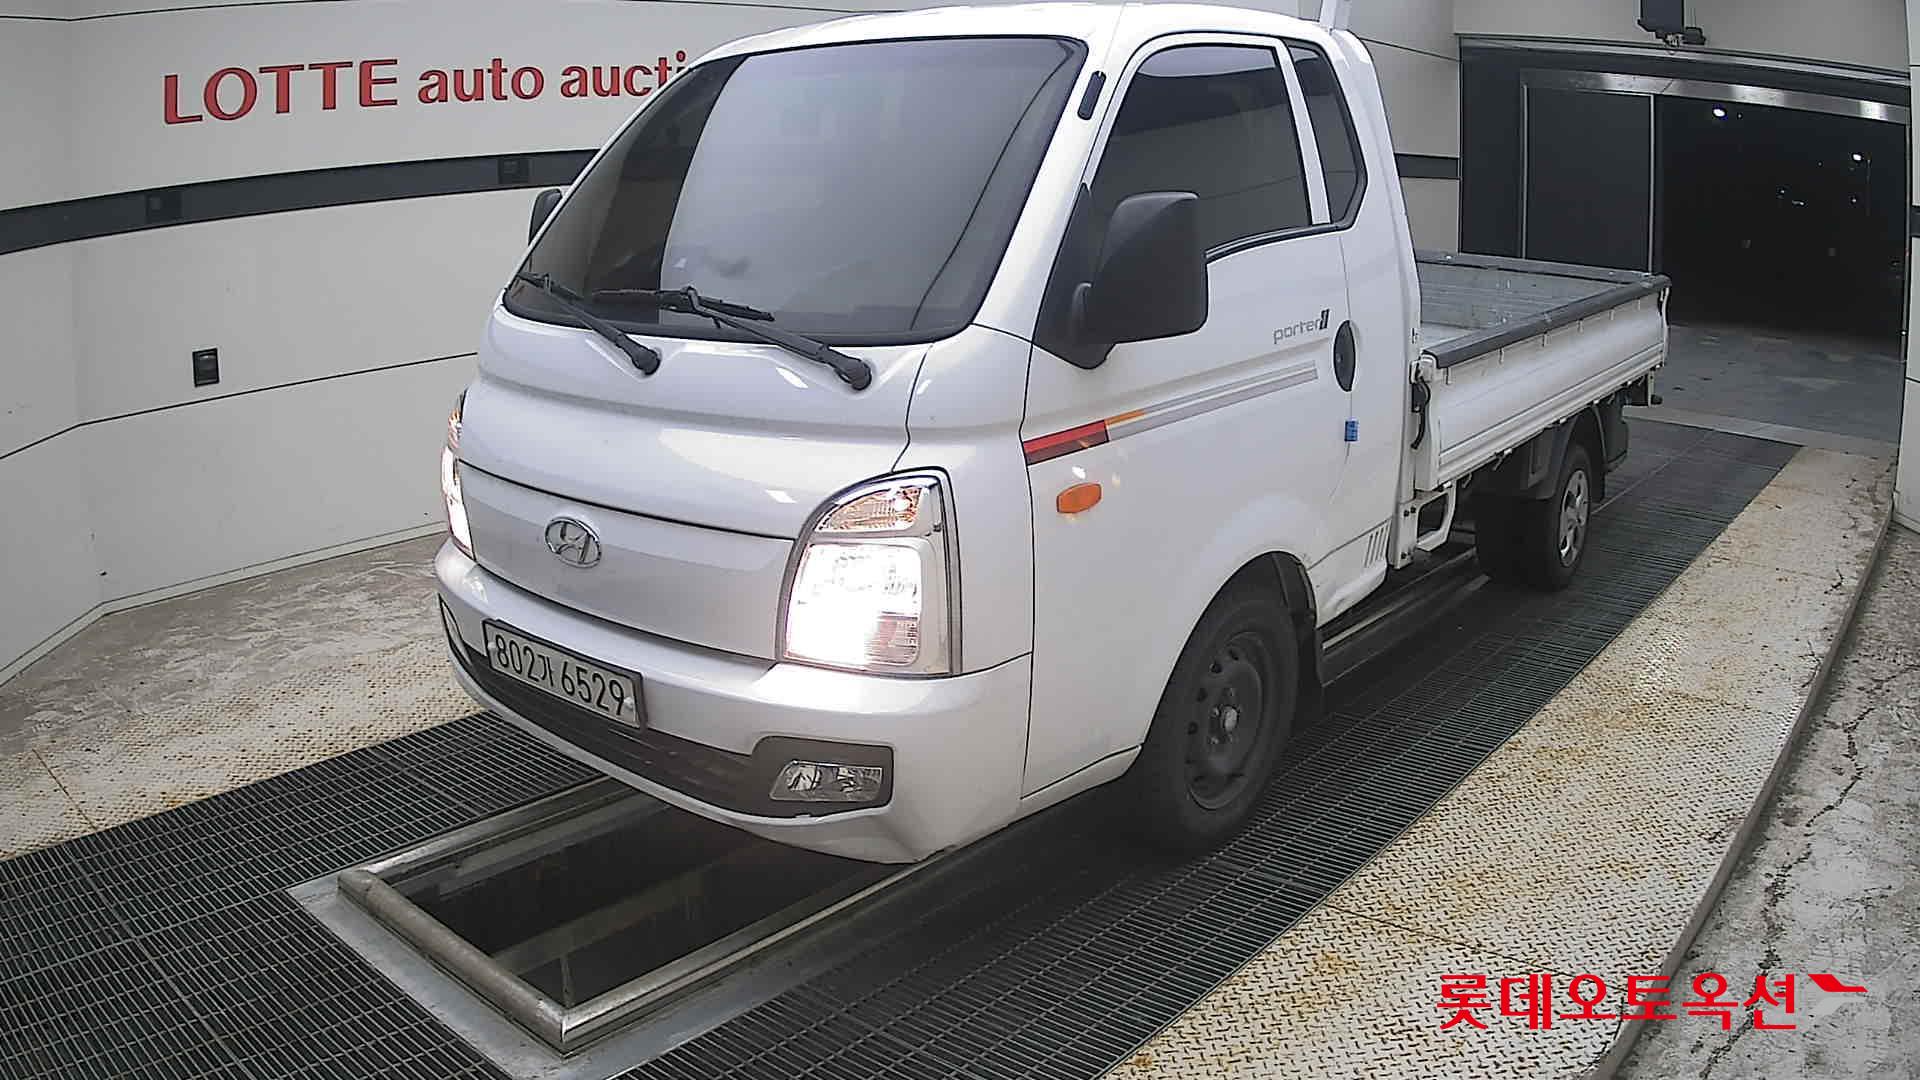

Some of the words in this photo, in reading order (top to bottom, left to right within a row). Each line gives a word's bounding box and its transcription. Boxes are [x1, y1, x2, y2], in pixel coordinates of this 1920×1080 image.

[164, 59, 398, 125] LOTTE
[418, 58, 545, 104] auto
[561, 661, 626, 716] 6529
